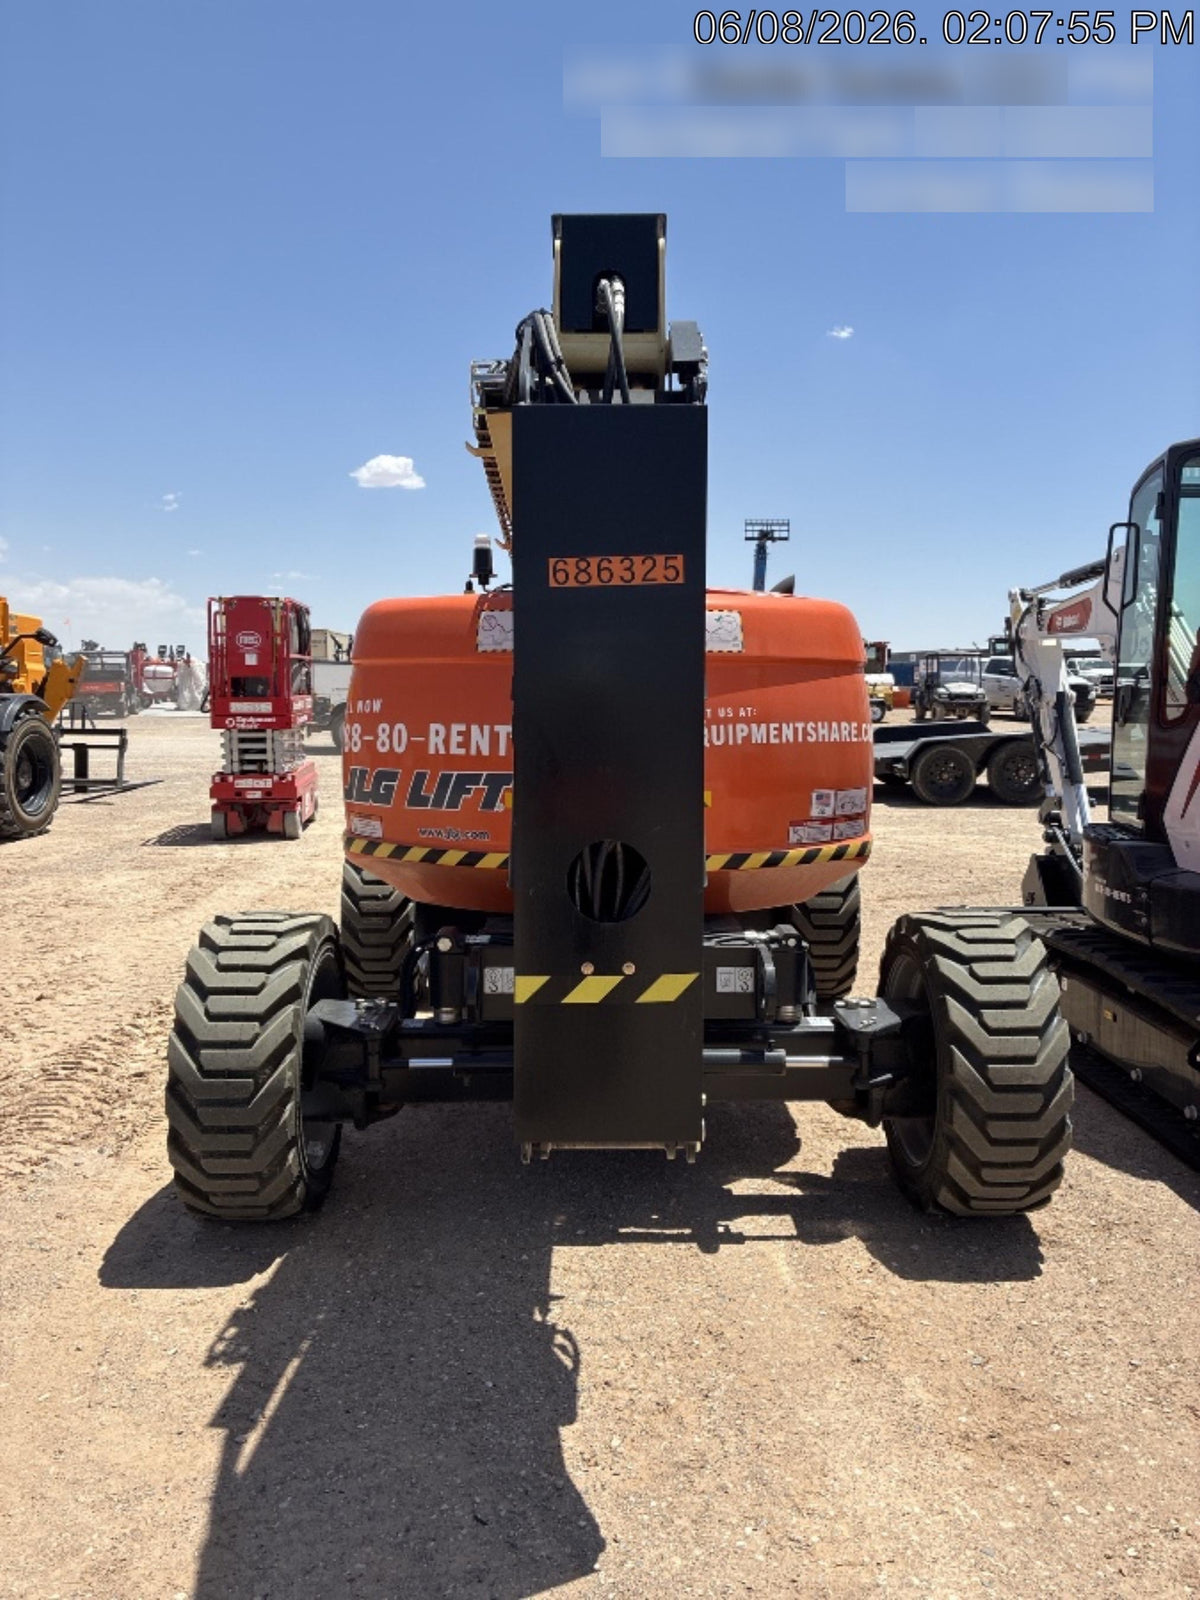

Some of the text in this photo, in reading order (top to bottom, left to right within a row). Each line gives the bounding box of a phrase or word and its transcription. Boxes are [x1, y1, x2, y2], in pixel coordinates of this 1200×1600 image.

[552, 556, 680, 586] 686325
[357, 699, 383, 714] NOW
[718, 707, 734, 718] US
[739, 707, 757, 718] AT:
[343, 722, 512, 757] 88-80-RENT
[345, 766, 513, 812] JLG LIFT
